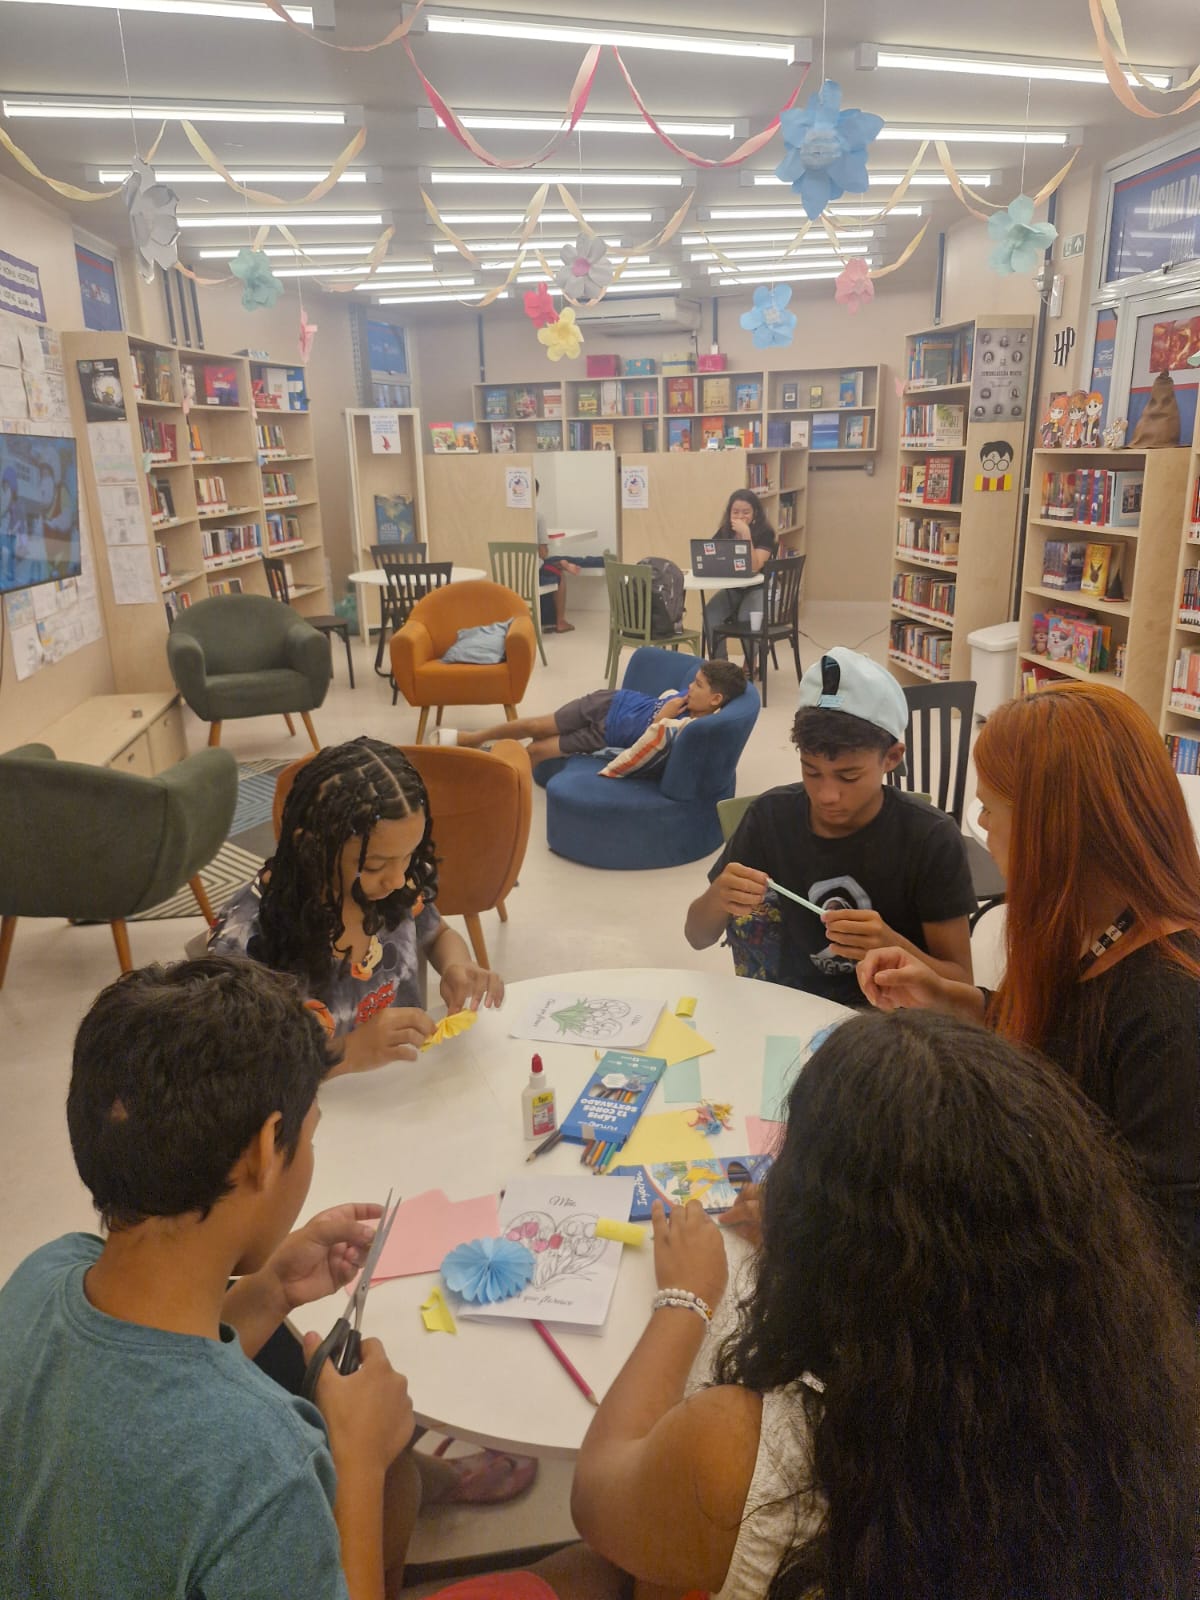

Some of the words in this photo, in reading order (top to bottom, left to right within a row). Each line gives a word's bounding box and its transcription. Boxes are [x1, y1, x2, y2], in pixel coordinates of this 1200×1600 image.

[583, 1105, 616, 1116] CORES
[617, 1109, 627, 1118] 12
[587, 1111, 617, 1122] LÁPIS
